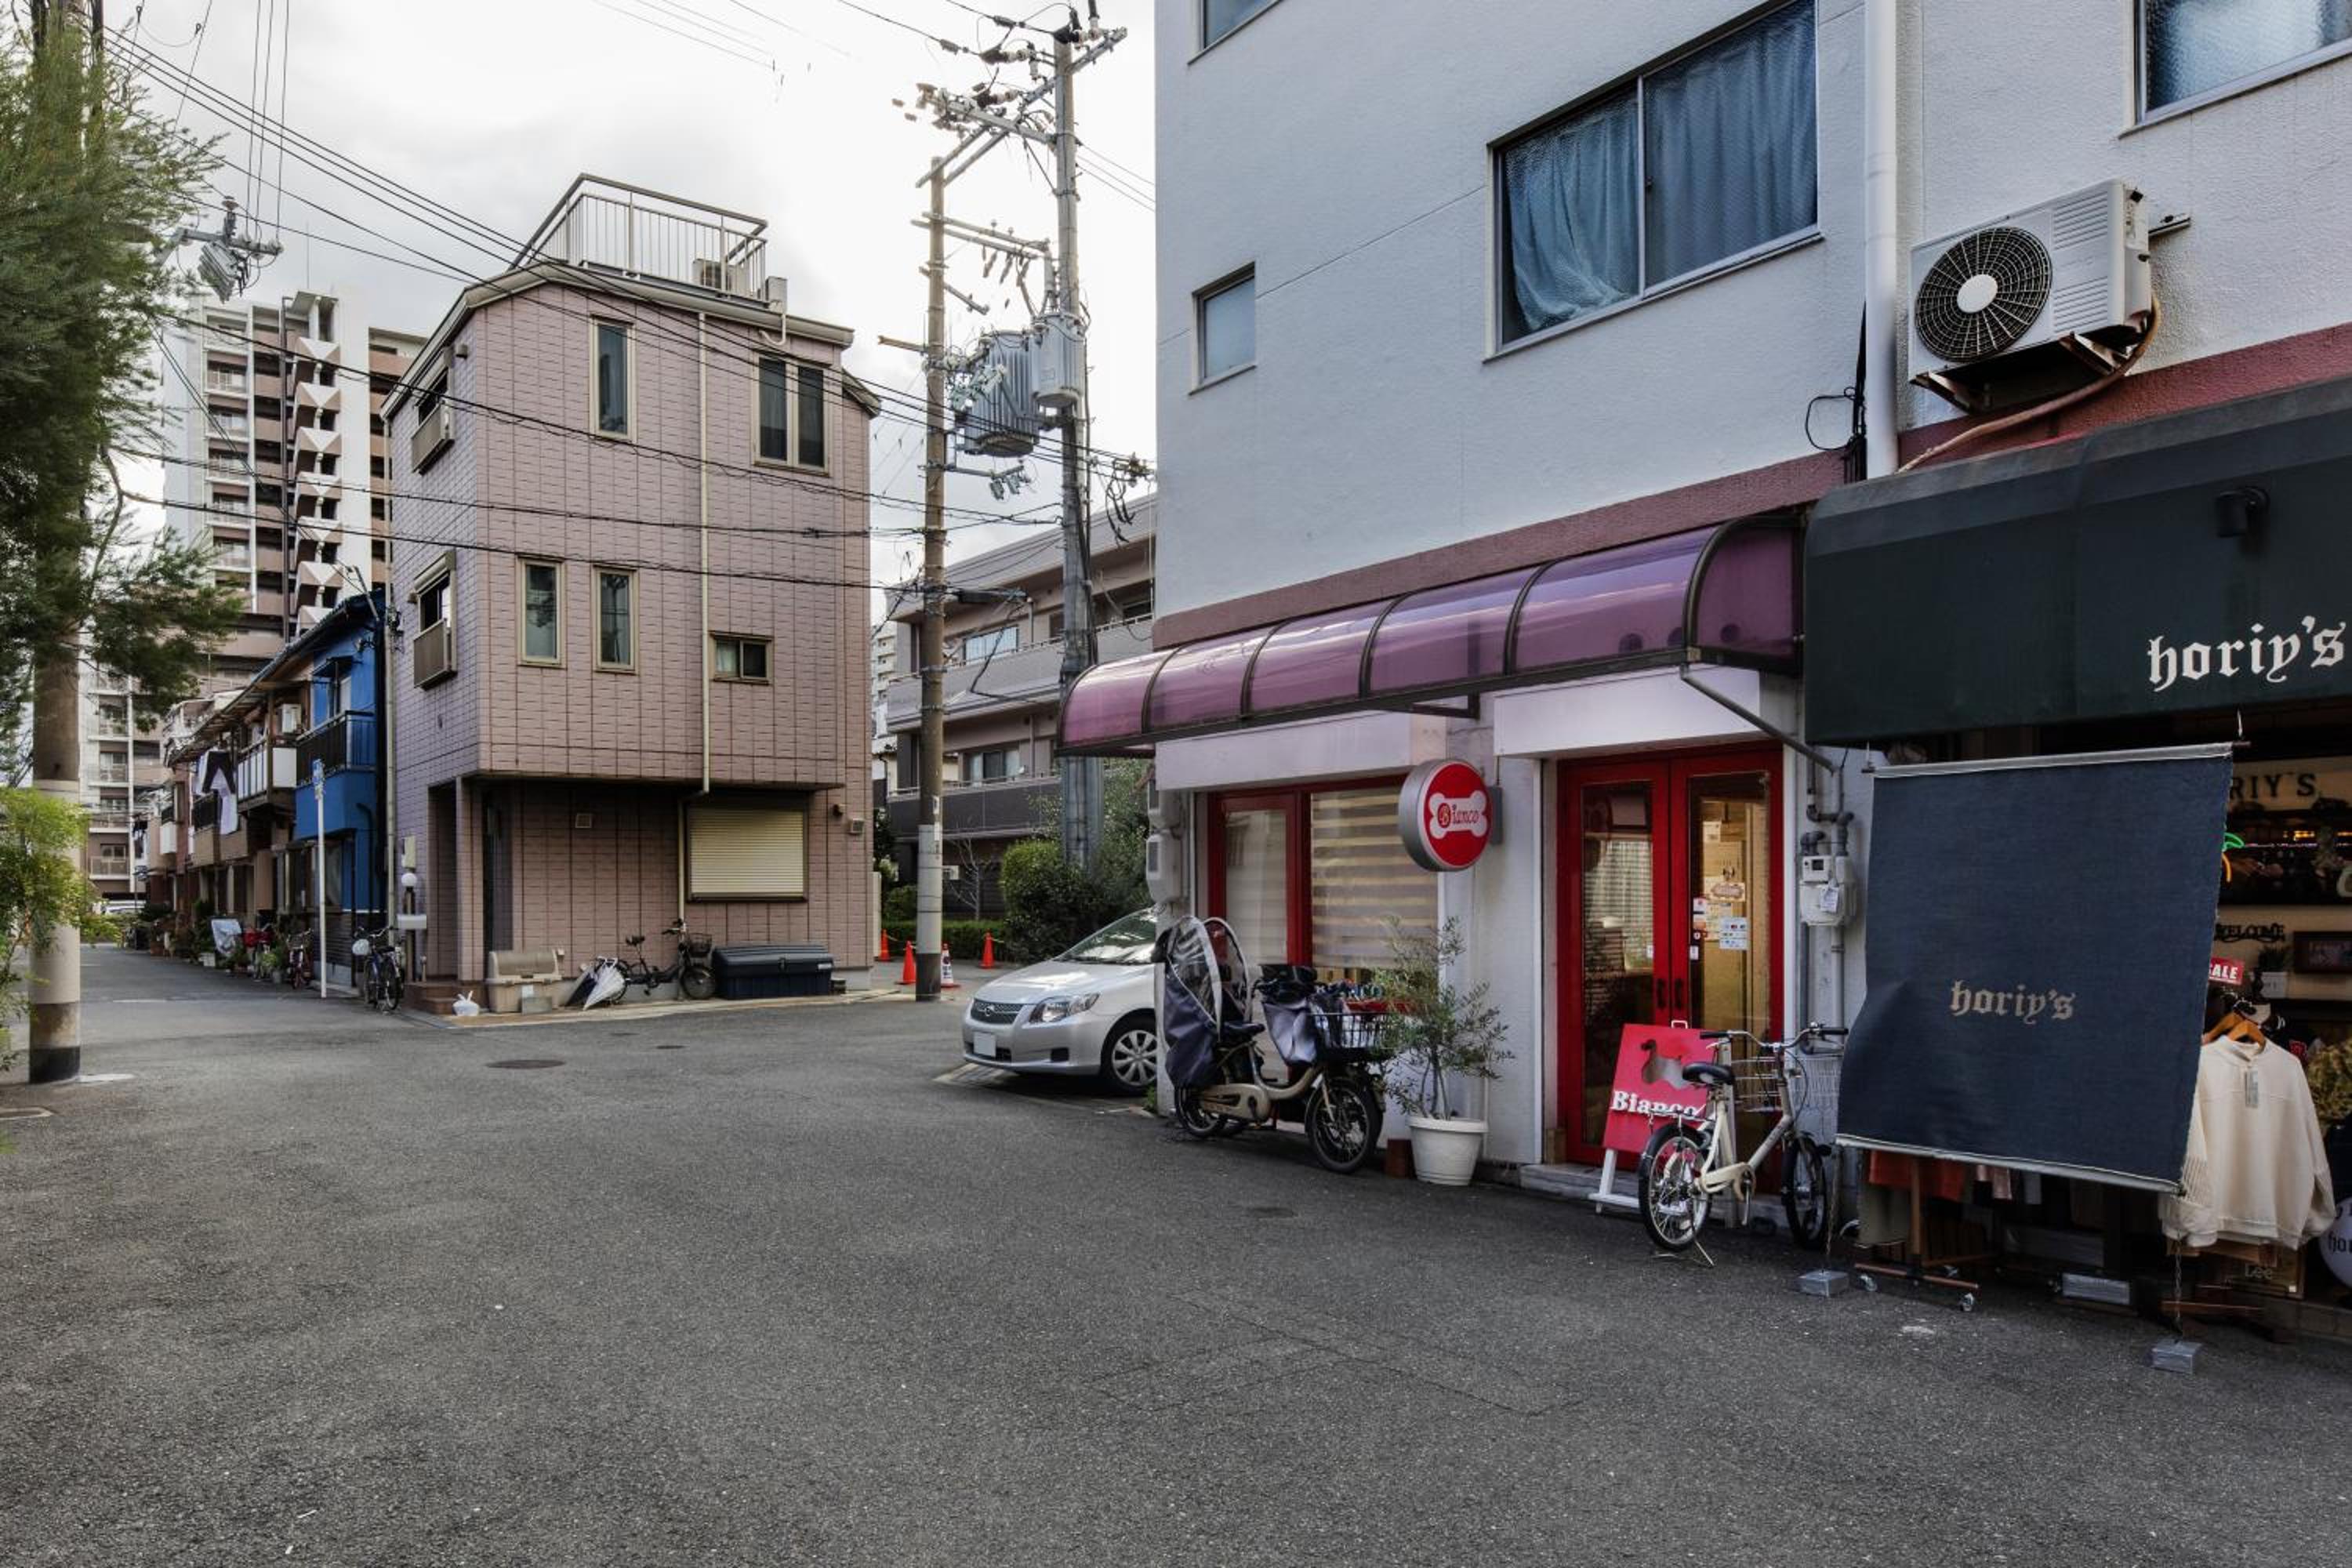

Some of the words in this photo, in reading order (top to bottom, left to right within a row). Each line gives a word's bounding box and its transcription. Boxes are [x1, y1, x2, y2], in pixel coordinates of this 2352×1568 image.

[2147, 615, 2347, 692] horiy's
[1438, 802, 1479, 828] Bianco
[1950, 979, 2076, 1025] horiy's
